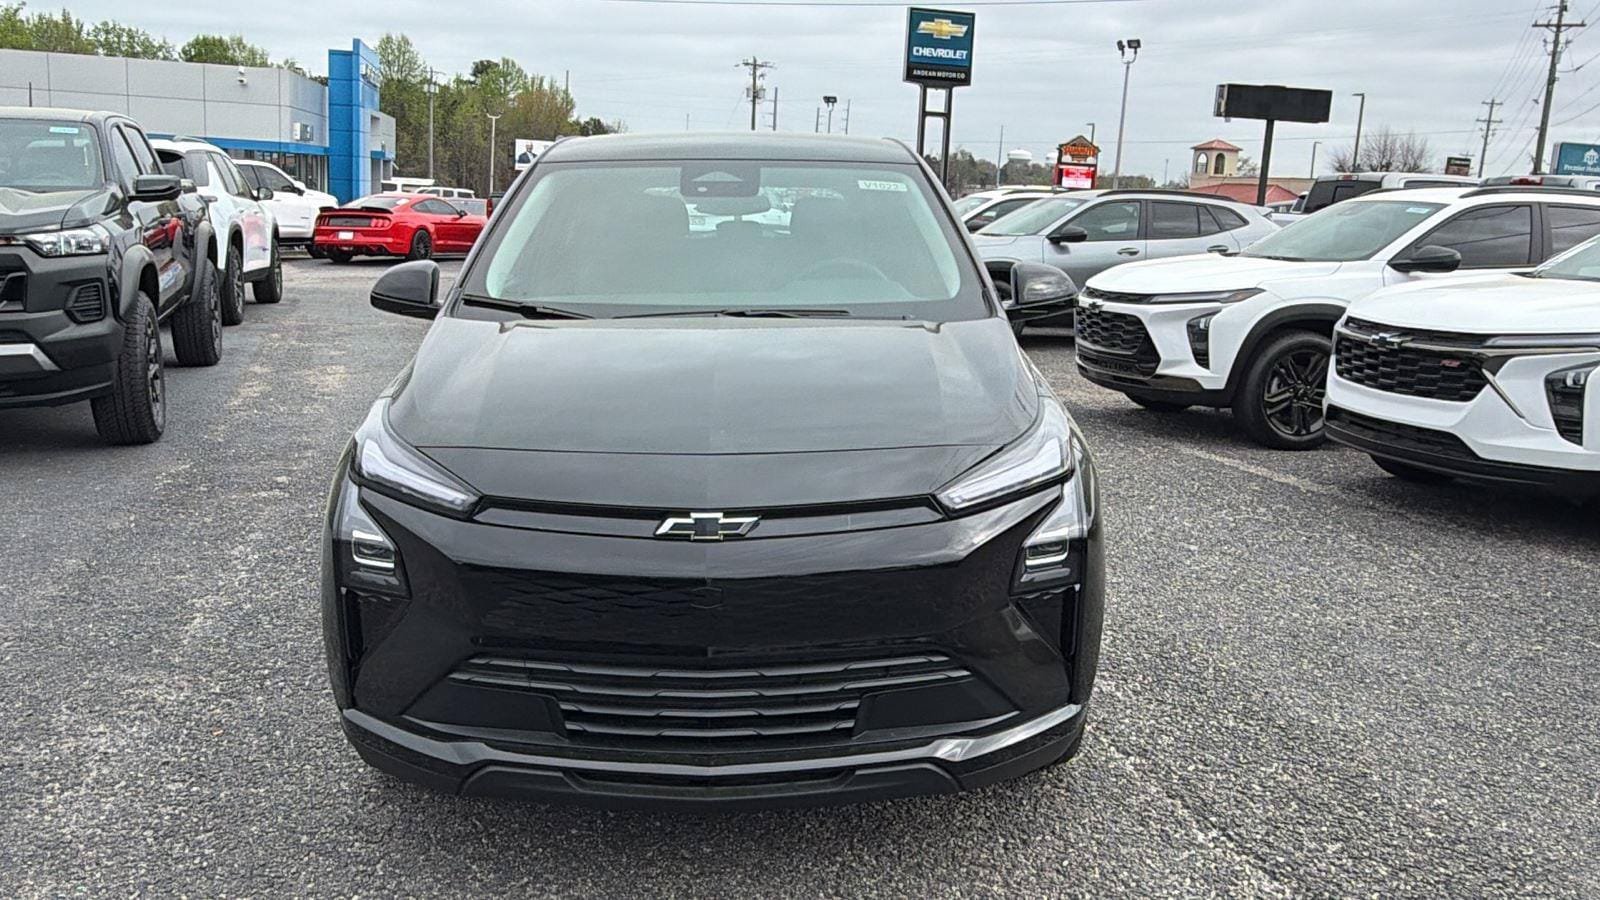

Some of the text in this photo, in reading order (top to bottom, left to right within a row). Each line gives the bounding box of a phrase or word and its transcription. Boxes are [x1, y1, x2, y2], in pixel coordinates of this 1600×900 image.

[913, 46, 968, 59] CHEVROLET
[913, 69, 936, 77] ANDEAN
[937, 71, 956, 79] MOTOR
